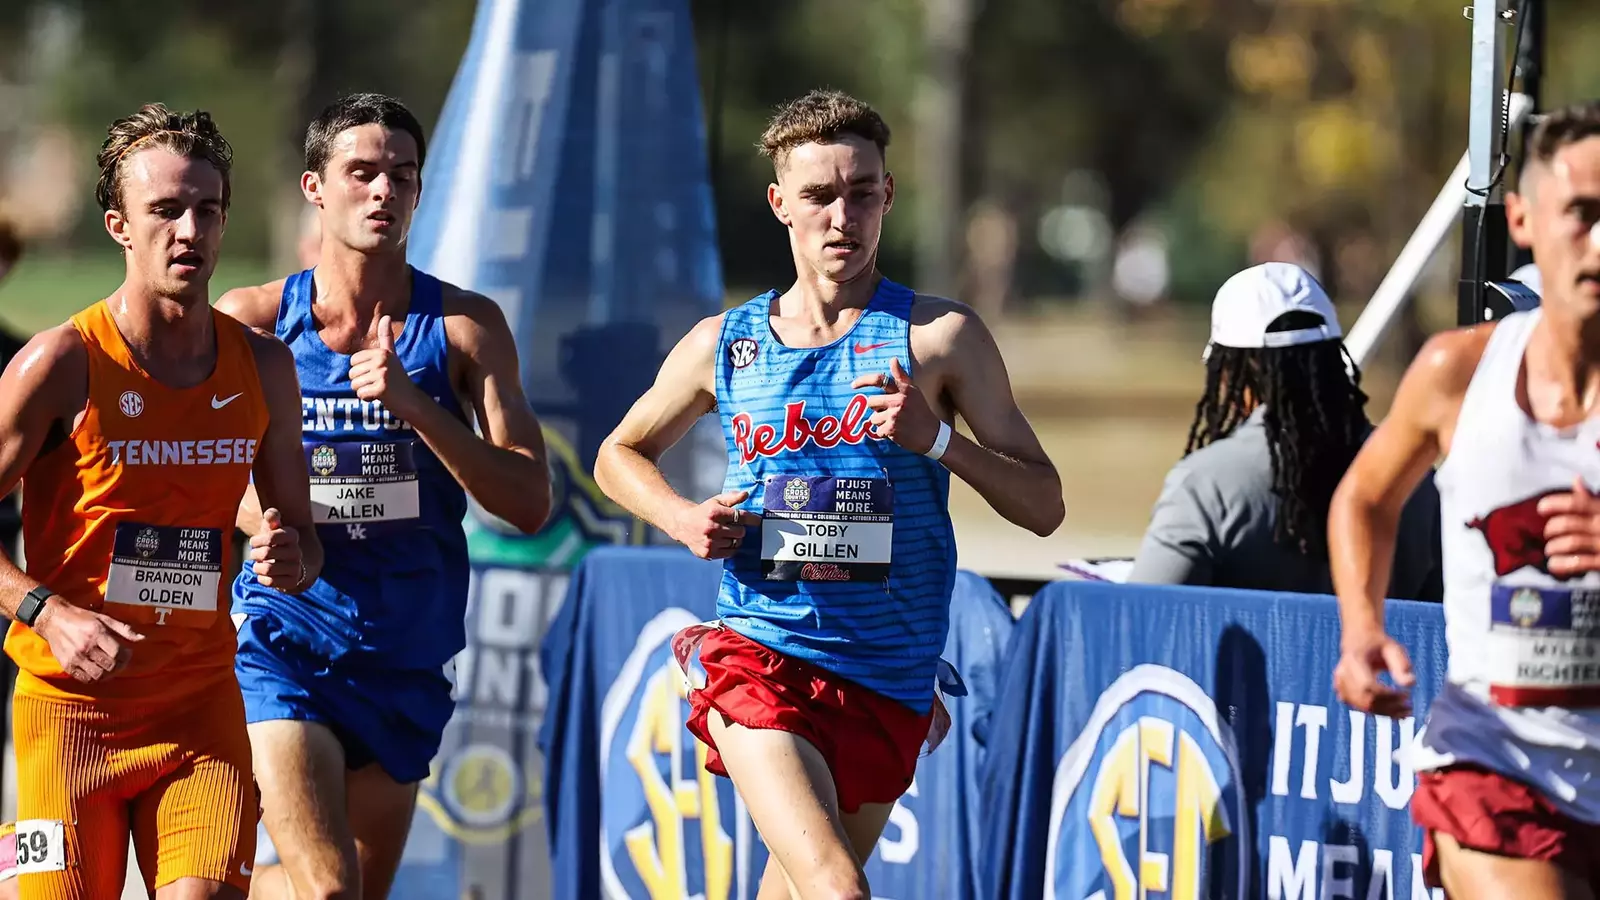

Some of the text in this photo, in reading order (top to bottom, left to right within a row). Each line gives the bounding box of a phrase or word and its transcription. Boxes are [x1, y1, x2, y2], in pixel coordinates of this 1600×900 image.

[121, 392, 142, 415] SEC
[301, 397, 411, 431] ENTUC
[107, 438, 256, 465] TENNESSEE
[361, 444, 396, 454] IT JUST
[361, 454, 396, 464] MEANS
[836, 479, 873, 489] IT JUST
[337, 487, 375, 500] JAKE
[836, 490, 872, 500] MEANS
[327, 504, 385, 519] ALLEN
[180, 529, 211, 540] IT JUST
[806, 524, 849, 537] TOBY
[136, 536, 158, 545] CROSS
[178, 540, 209, 550] MEANS
[793, 543, 858, 558] GILLEN
[135, 569, 202, 587] BRANDON
[138, 588, 194, 606] OLDEN
[155, 607, 172, 625] T
[1517, 664, 1600, 681] RICHTE
[1272, 701, 1416, 810] IT JU
[16, 829, 48, 864] 59
